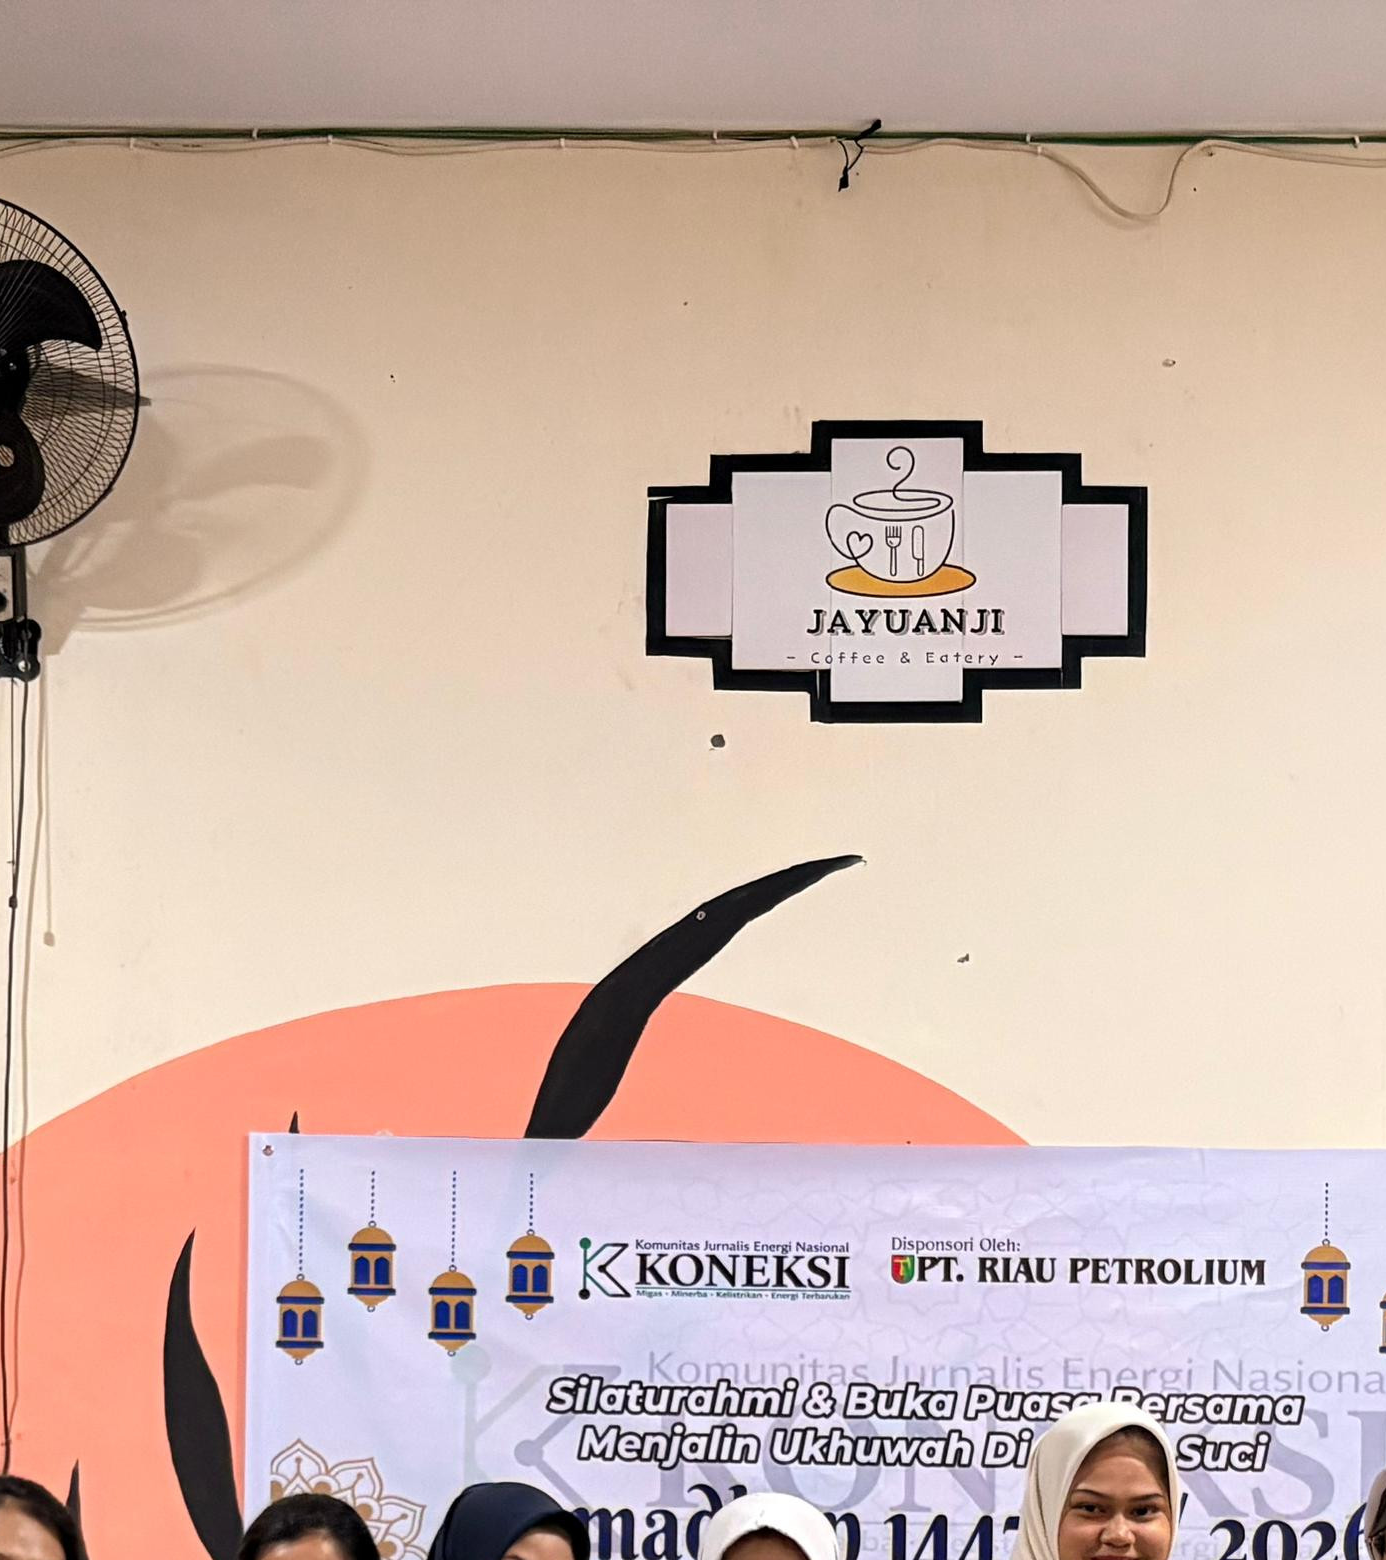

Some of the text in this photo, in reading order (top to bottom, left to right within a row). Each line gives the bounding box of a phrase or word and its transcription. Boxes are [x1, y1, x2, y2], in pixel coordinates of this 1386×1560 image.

[806, 608, 1005, 635] JAYUANJI
[811, 651, 885, 665] Coffee
[900, 652, 911, 664] &
[926, 651, 999, 666] Eatery
[635, 1239, 849, 1255] Komunitas Jurnalis Energi Nasional
[891, 1236, 1021, 1254] Disponsori Oleh:
[635, 1253, 851, 1289] KONEKSI
[917, 1256, 1266, 1285] PT. RIAU PETROLIUM
[636, 1290, 662, 1299] Migas
[545, 1373, 799, 1417] Silaturahmi
[802, 1381, 837, 1418] &
[843, 1382, 958, 1421] Buka
[576, 1422, 1271, 1472] Menjalin Ukhuwah Di Suci
